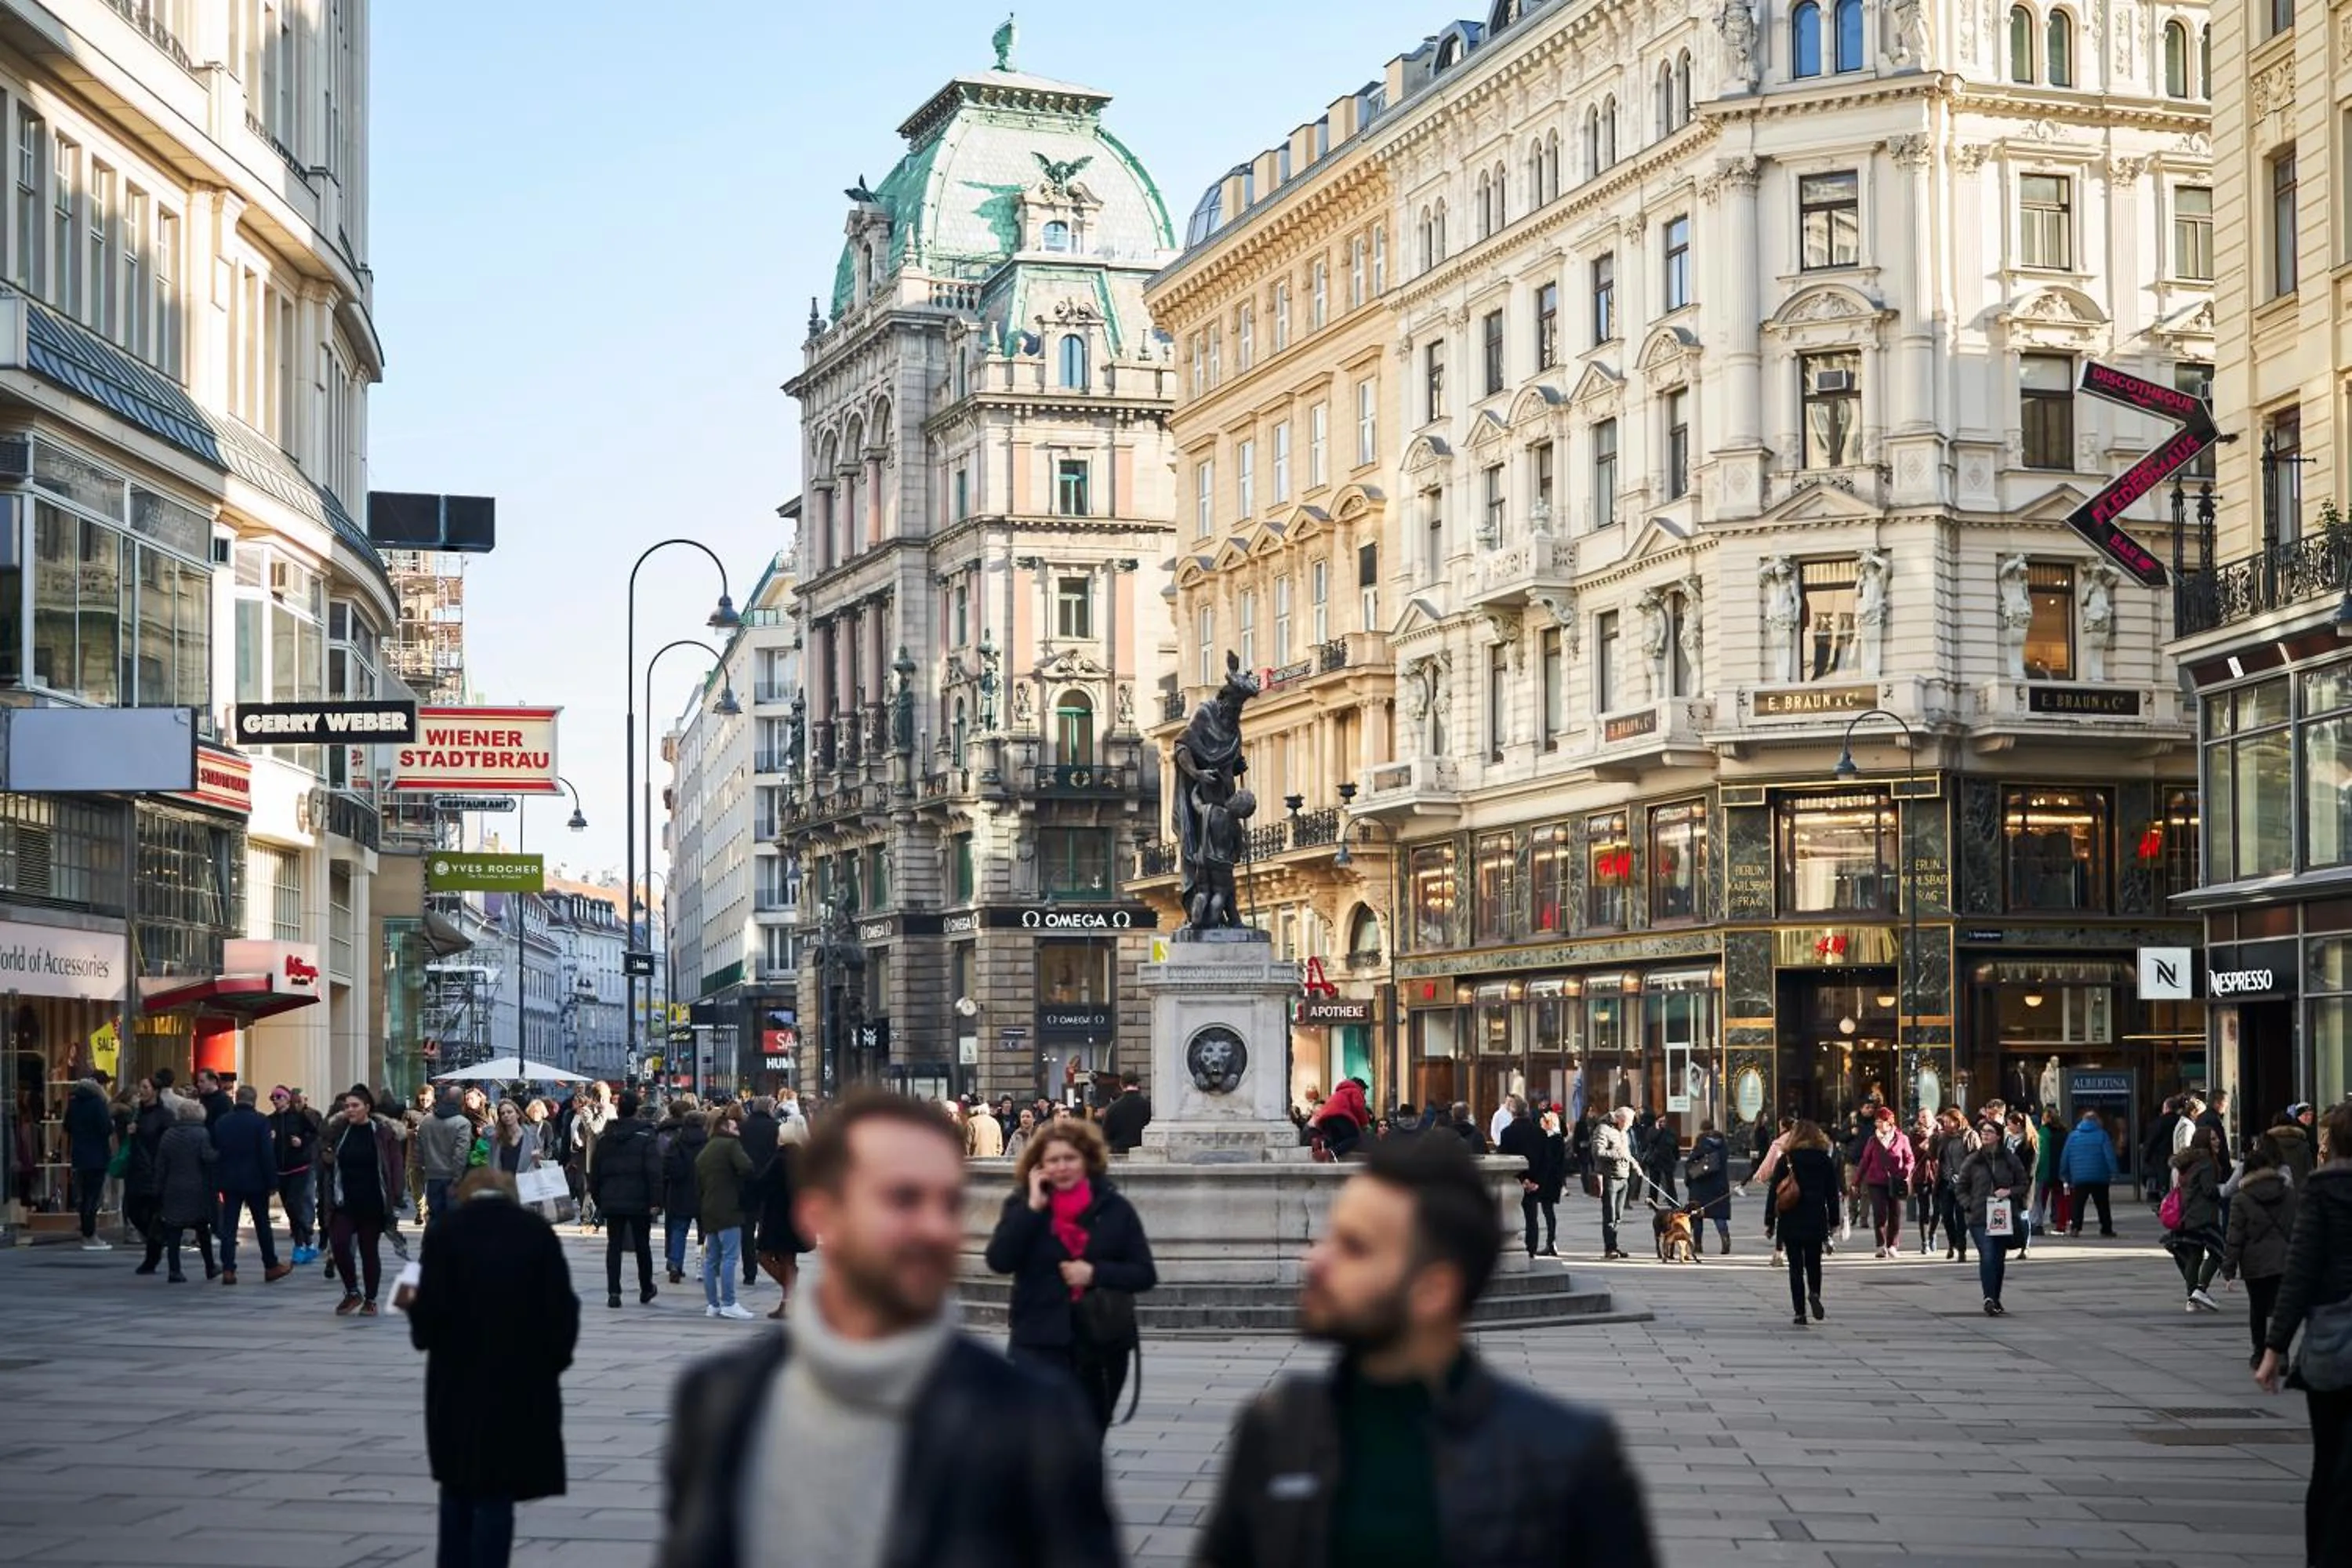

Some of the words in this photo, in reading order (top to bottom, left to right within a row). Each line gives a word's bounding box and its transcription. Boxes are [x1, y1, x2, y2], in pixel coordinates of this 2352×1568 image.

[2092, 367, 2195, 411] DISCOTHEQUE
[1784, 694, 1831, 710] BRAUN
[2056, 693, 2100, 709] BRAUN
[242, 713, 321, 734] GERRY
[324, 711, 408, 732] WEBER
[426, 729, 523, 747] WIENER
[399, 750, 550, 769] STADTBRÄU
[440, 800, 509, 809] RESTAURANT
[451, 863, 482, 873] YVES
[488, 865, 539, 874] ROCHER
[1903, 874, 1947, 886] KRLSBAD
[950, 917, 971, 931] OMEGA
[1045, 913, 1108, 928] OMEGA
[866, 924, 885, 938] OMEGA
[0, 944, 25, 972] orld
[28, 946, 42, 973] of
[43, 949, 110, 979] Accessories
[2208, 968, 2274, 997] NESPRESSO
[1309, 1005, 1365, 1018] APOTHEKE
[97, 1035, 115, 1052] SALE
